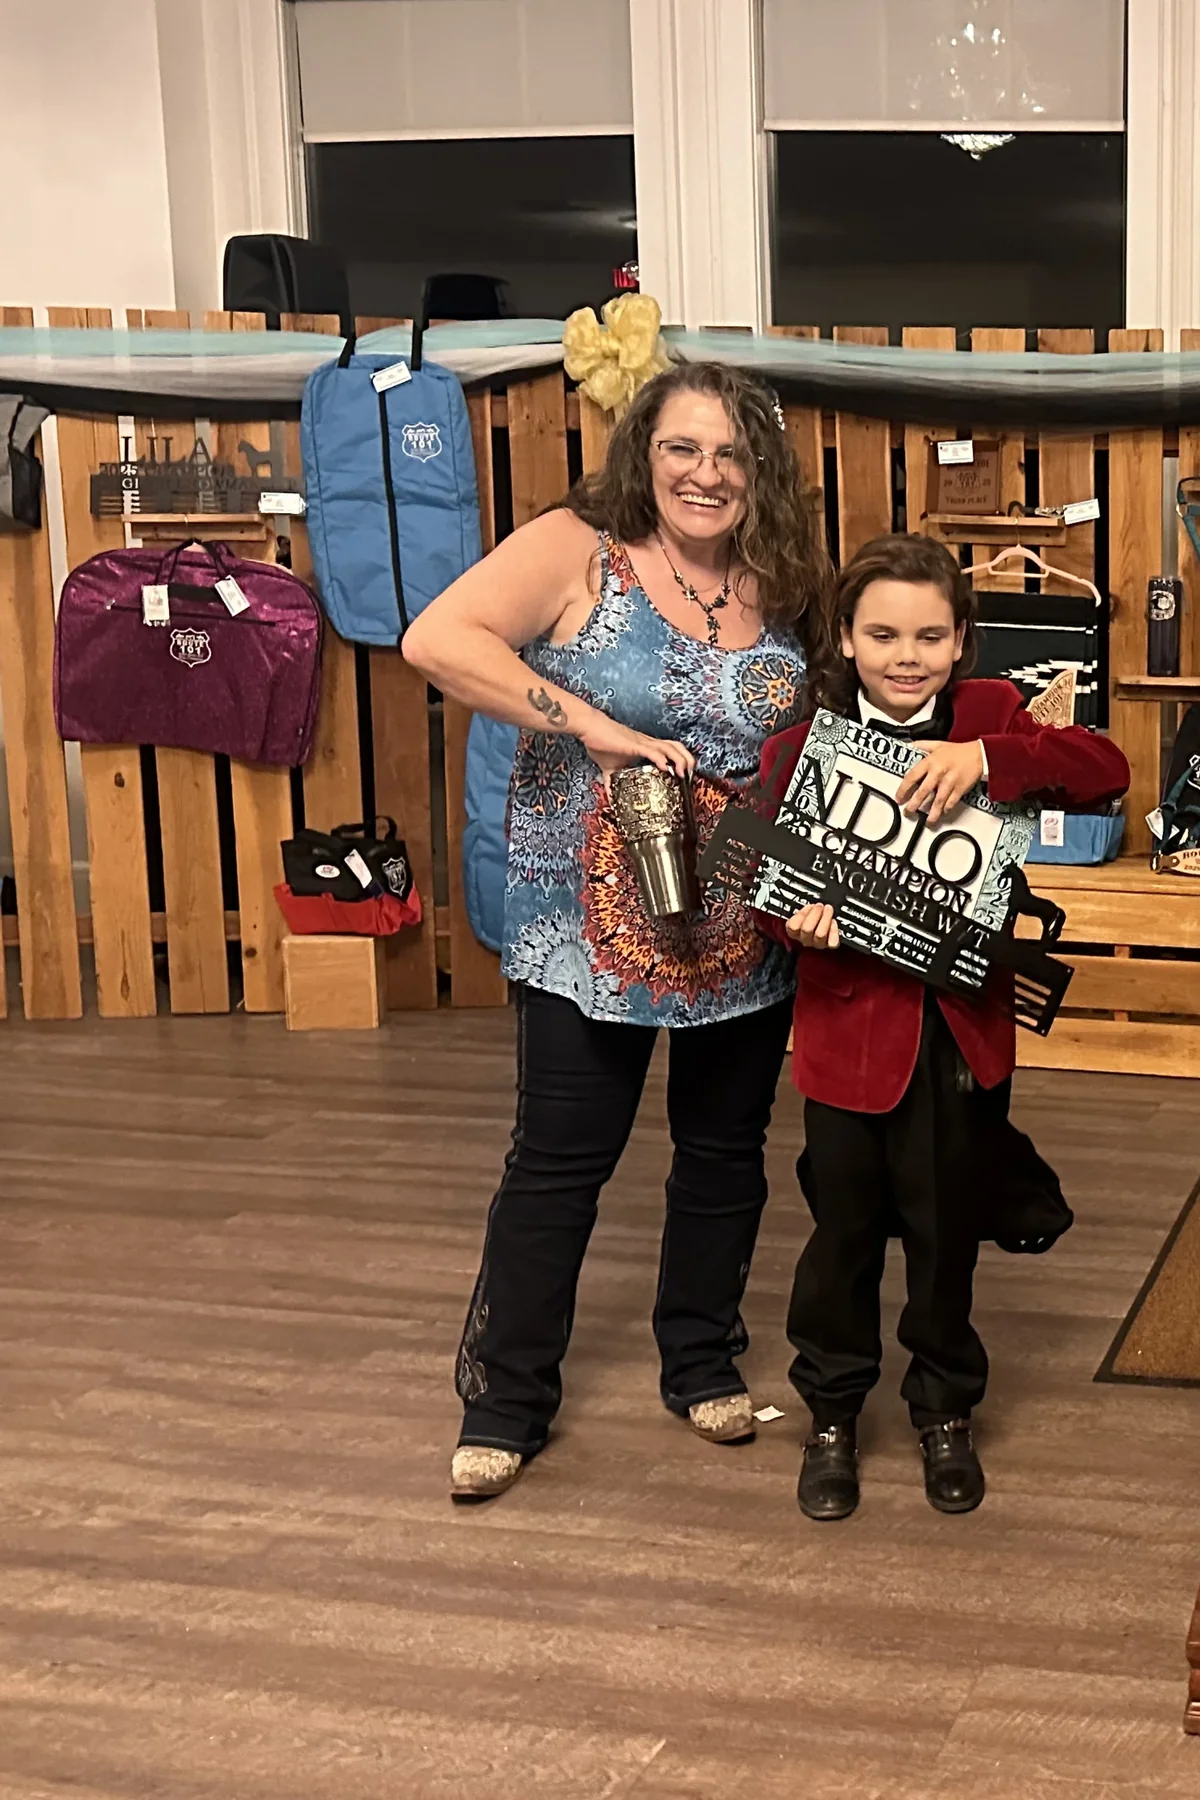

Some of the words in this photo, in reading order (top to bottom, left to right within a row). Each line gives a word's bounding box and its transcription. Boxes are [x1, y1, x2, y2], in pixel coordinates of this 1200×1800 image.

[121, 436, 213, 464] LILA
[411, 440, 432, 449] 101
[180, 645, 201, 655] 101
[1050, 693, 1063, 708] 101
[856, 746, 909, 776] RESERV
[821, 829, 972, 916] CHAMPION
[811, 852, 927, 922] ENGLISH
